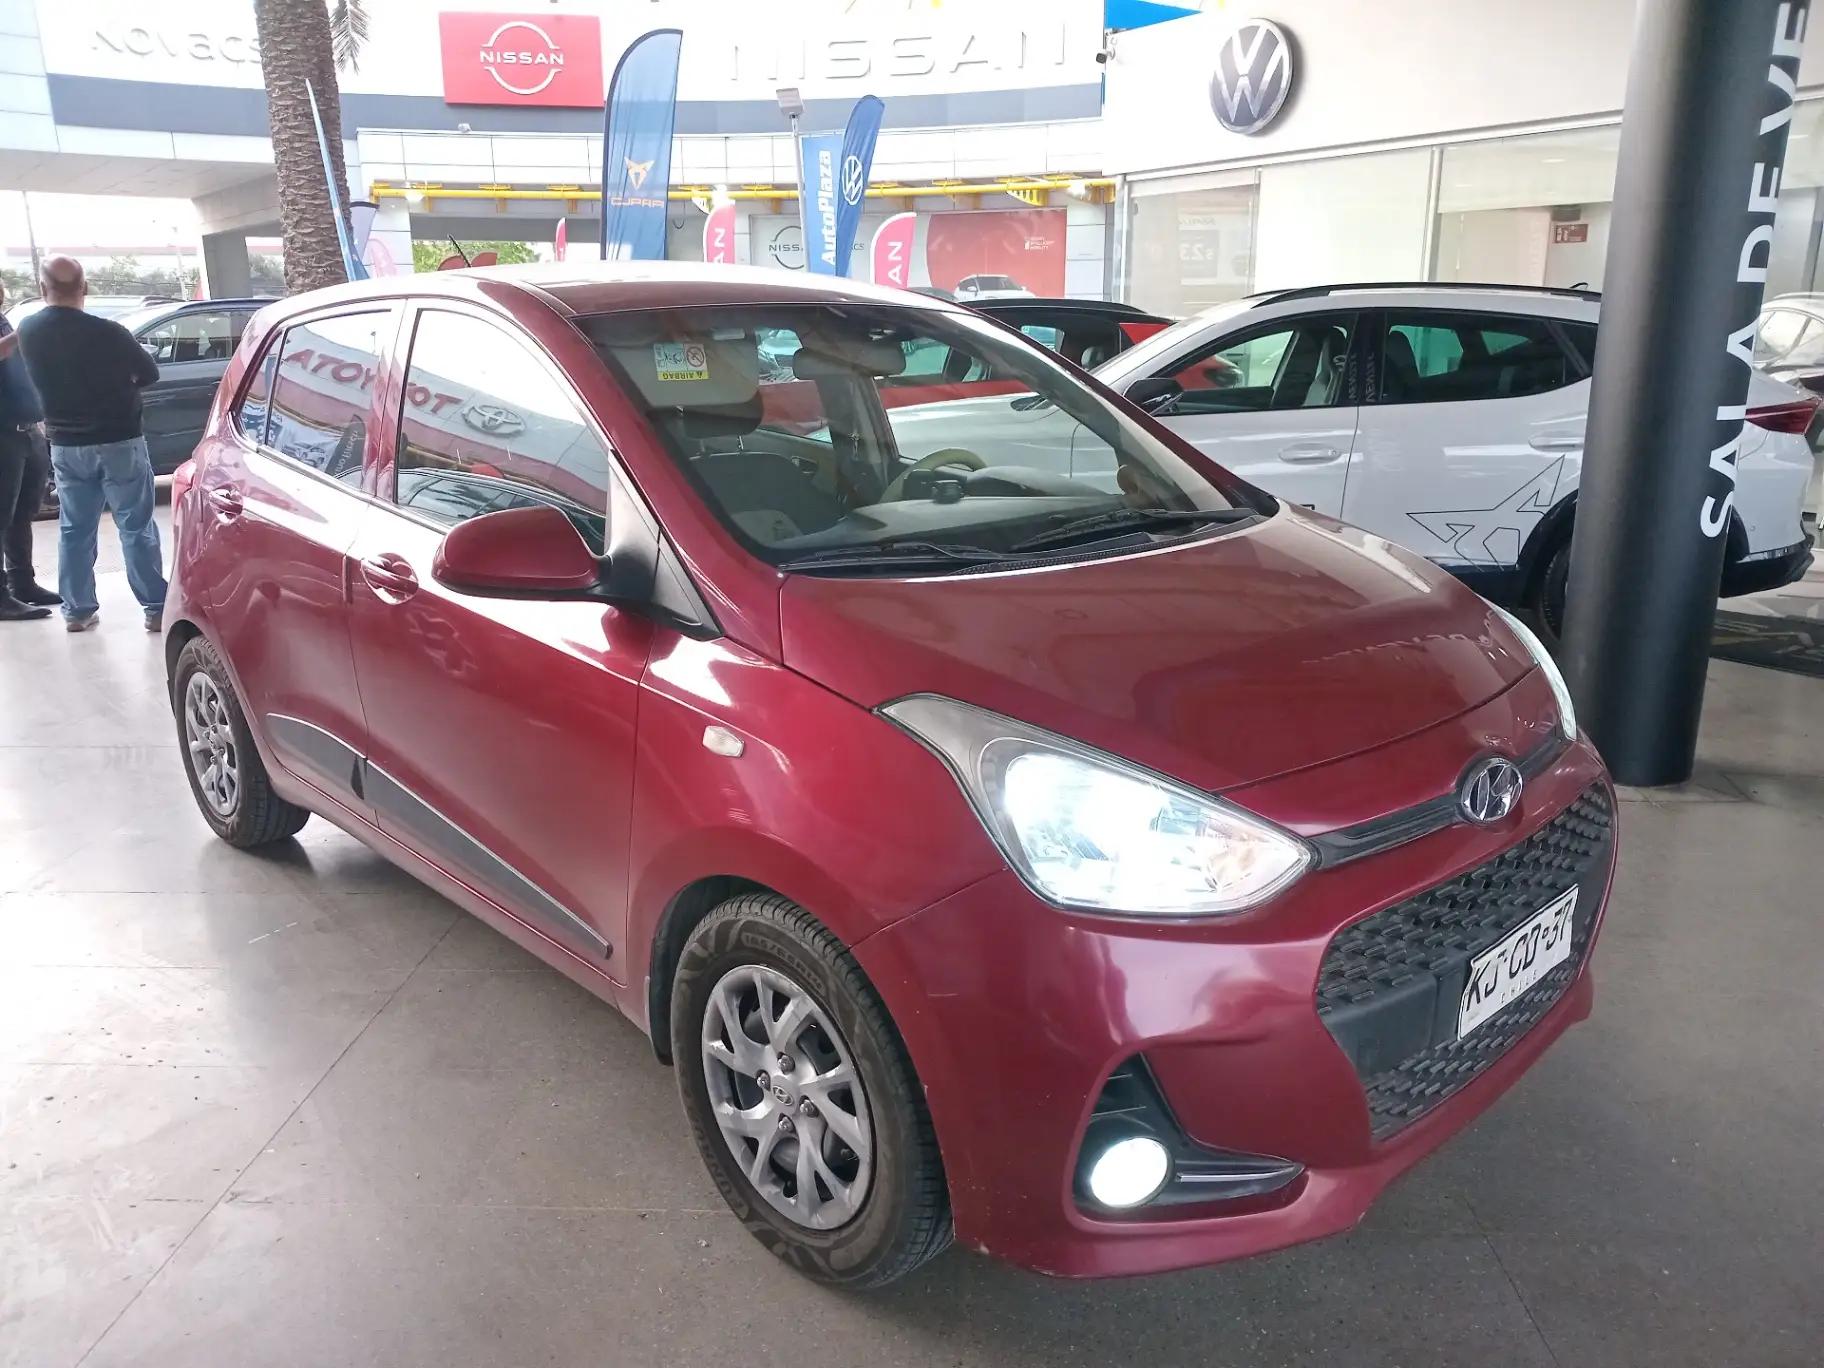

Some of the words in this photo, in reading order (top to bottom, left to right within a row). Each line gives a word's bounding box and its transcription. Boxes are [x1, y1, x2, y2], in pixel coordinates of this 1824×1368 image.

[480, 50, 564, 65] NISSAN
[730, 23, 1066, 81] NISSAN
[610, 197, 665, 209] CUPRA
[818, 149, 837, 267] AutoPlaza
[768, 243, 804, 253] NISS
[662, 371, 695, 380] AIRBAG
